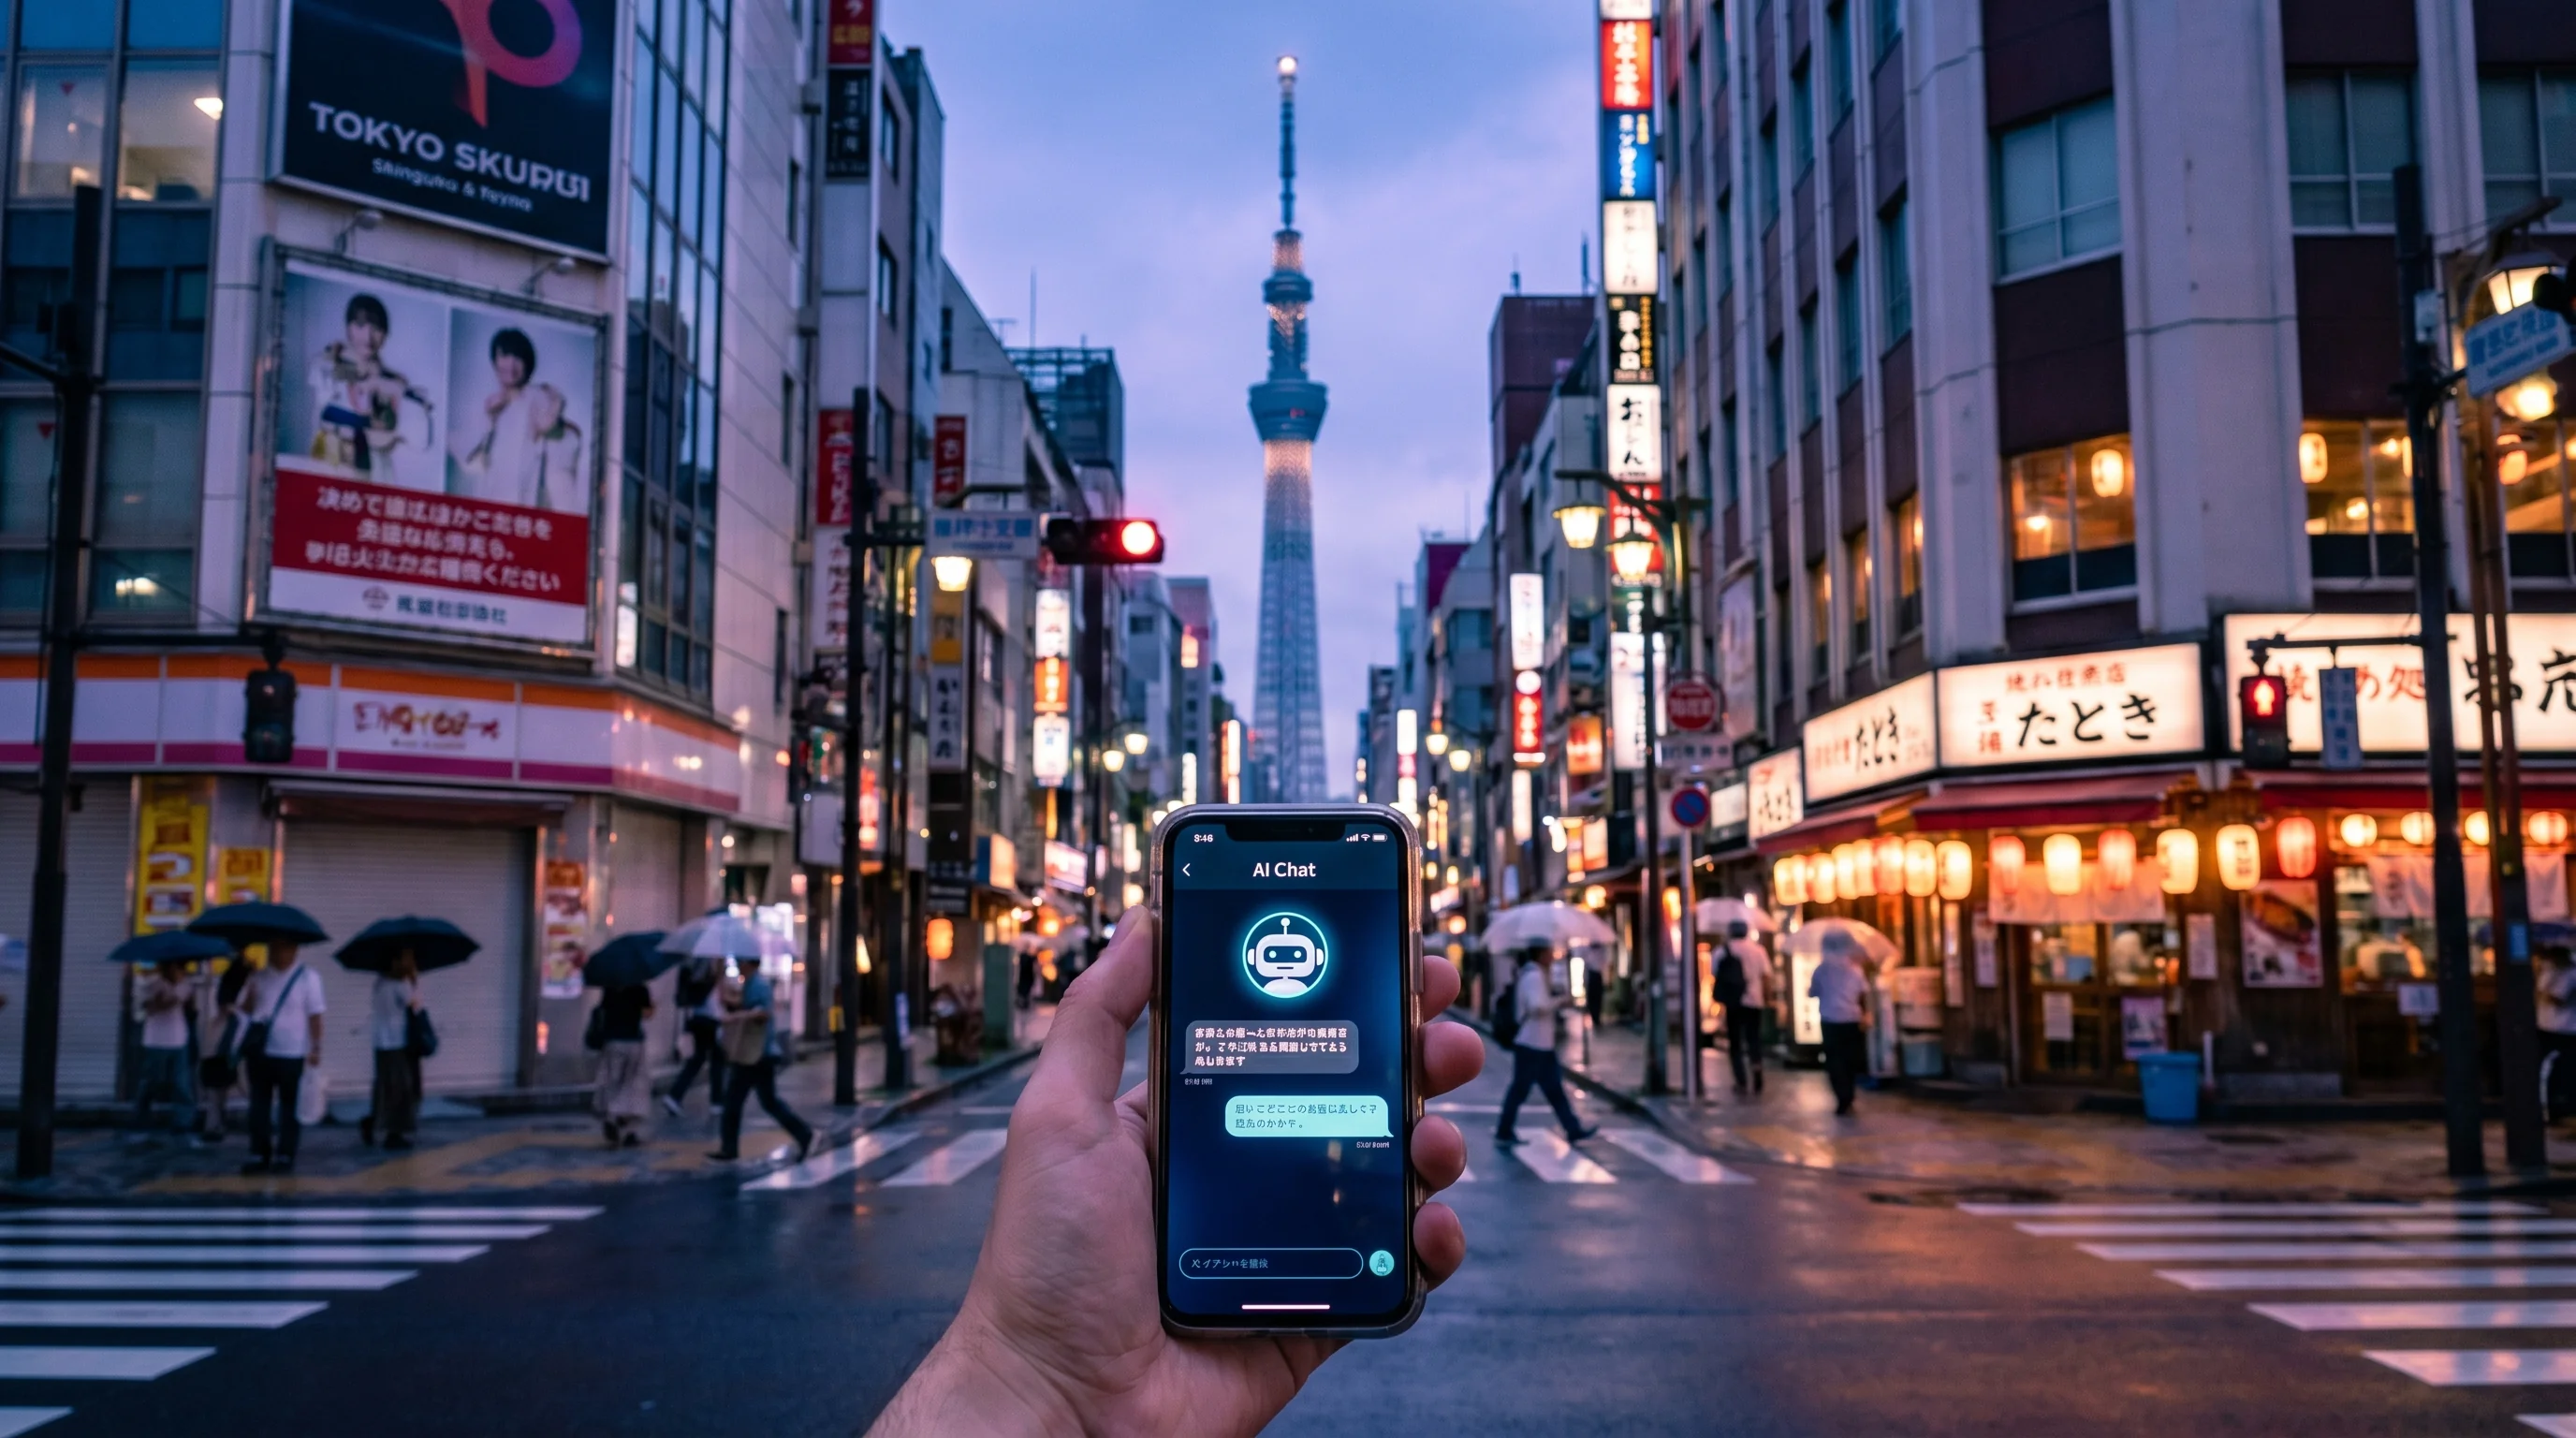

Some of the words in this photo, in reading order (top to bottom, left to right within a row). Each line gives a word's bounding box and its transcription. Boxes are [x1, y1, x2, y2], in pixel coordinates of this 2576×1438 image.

[308, 101, 446, 162] TOKYO
[2017, 693, 2157, 748] たとき
[1252, 862, 1270, 877] AI
[1274, 861, 1316, 877] Chat
